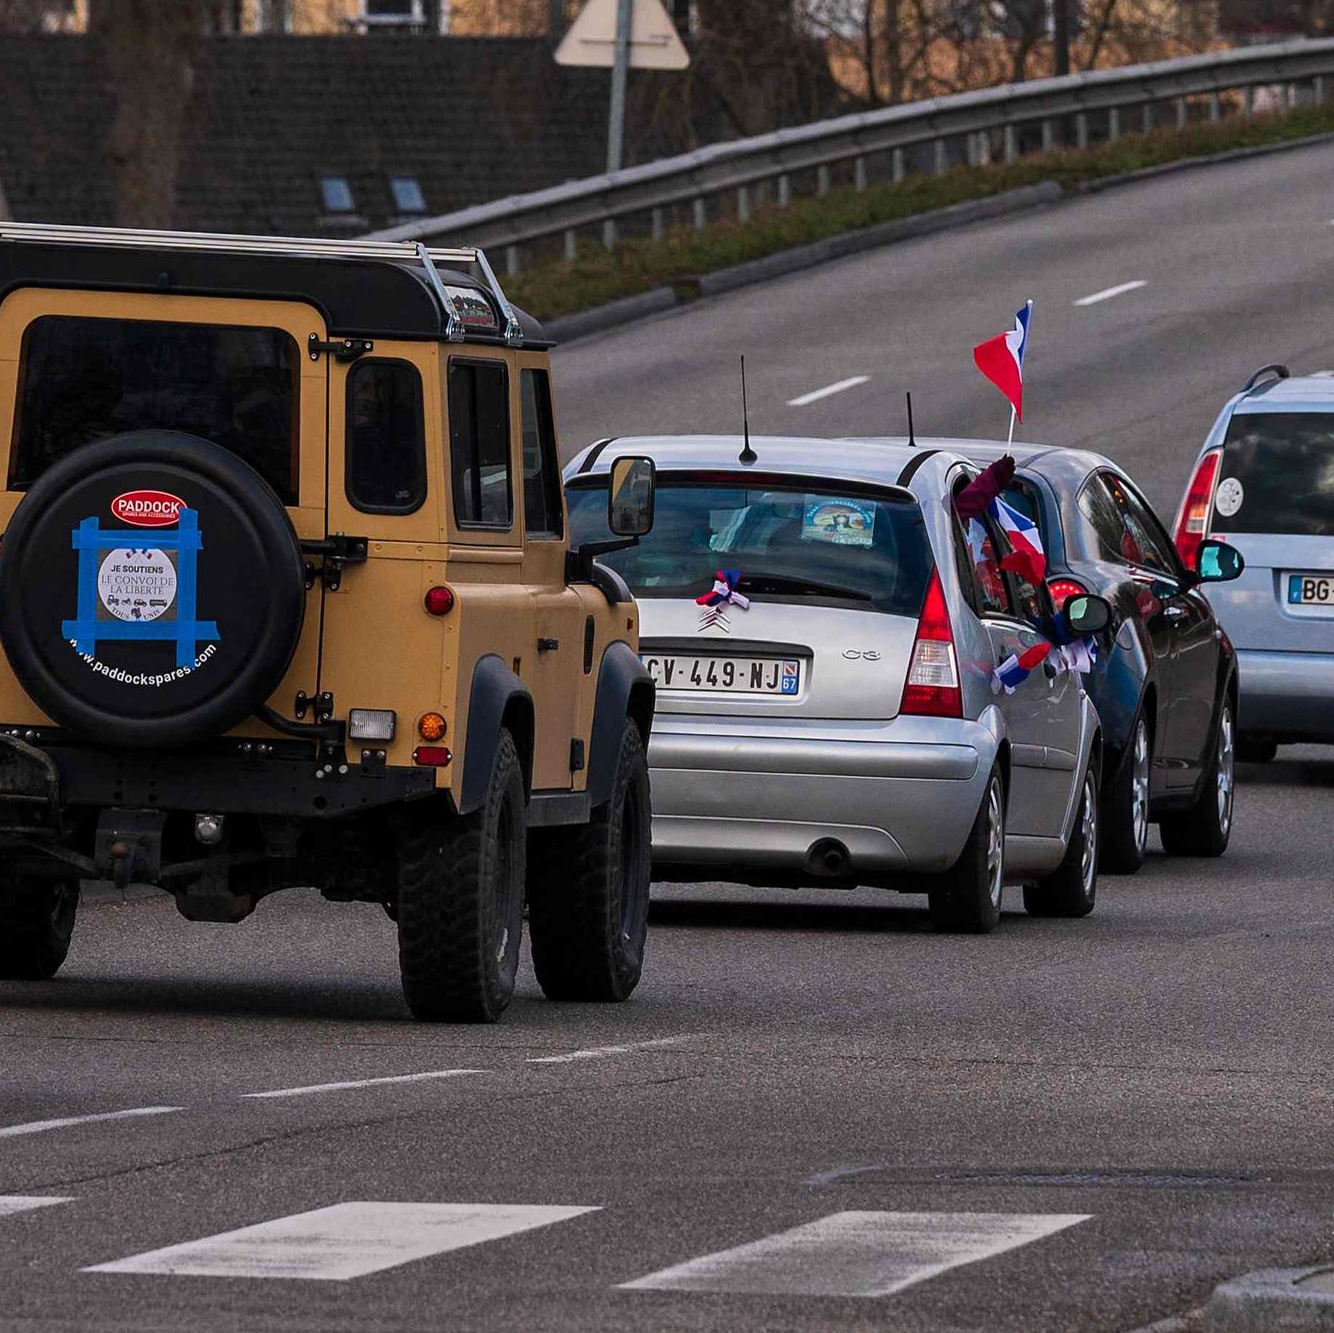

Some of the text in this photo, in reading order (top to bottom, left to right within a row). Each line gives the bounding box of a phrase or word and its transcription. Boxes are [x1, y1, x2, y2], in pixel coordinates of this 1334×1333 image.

[119, 500, 180, 514] PADDOCK
[110, 565, 164, 574] JE SOUTIENS
[101, 575, 174, 587] LE CONVOI DE
[110, 585, 123, 595] LA
[782, 678, 797, 690] 67
